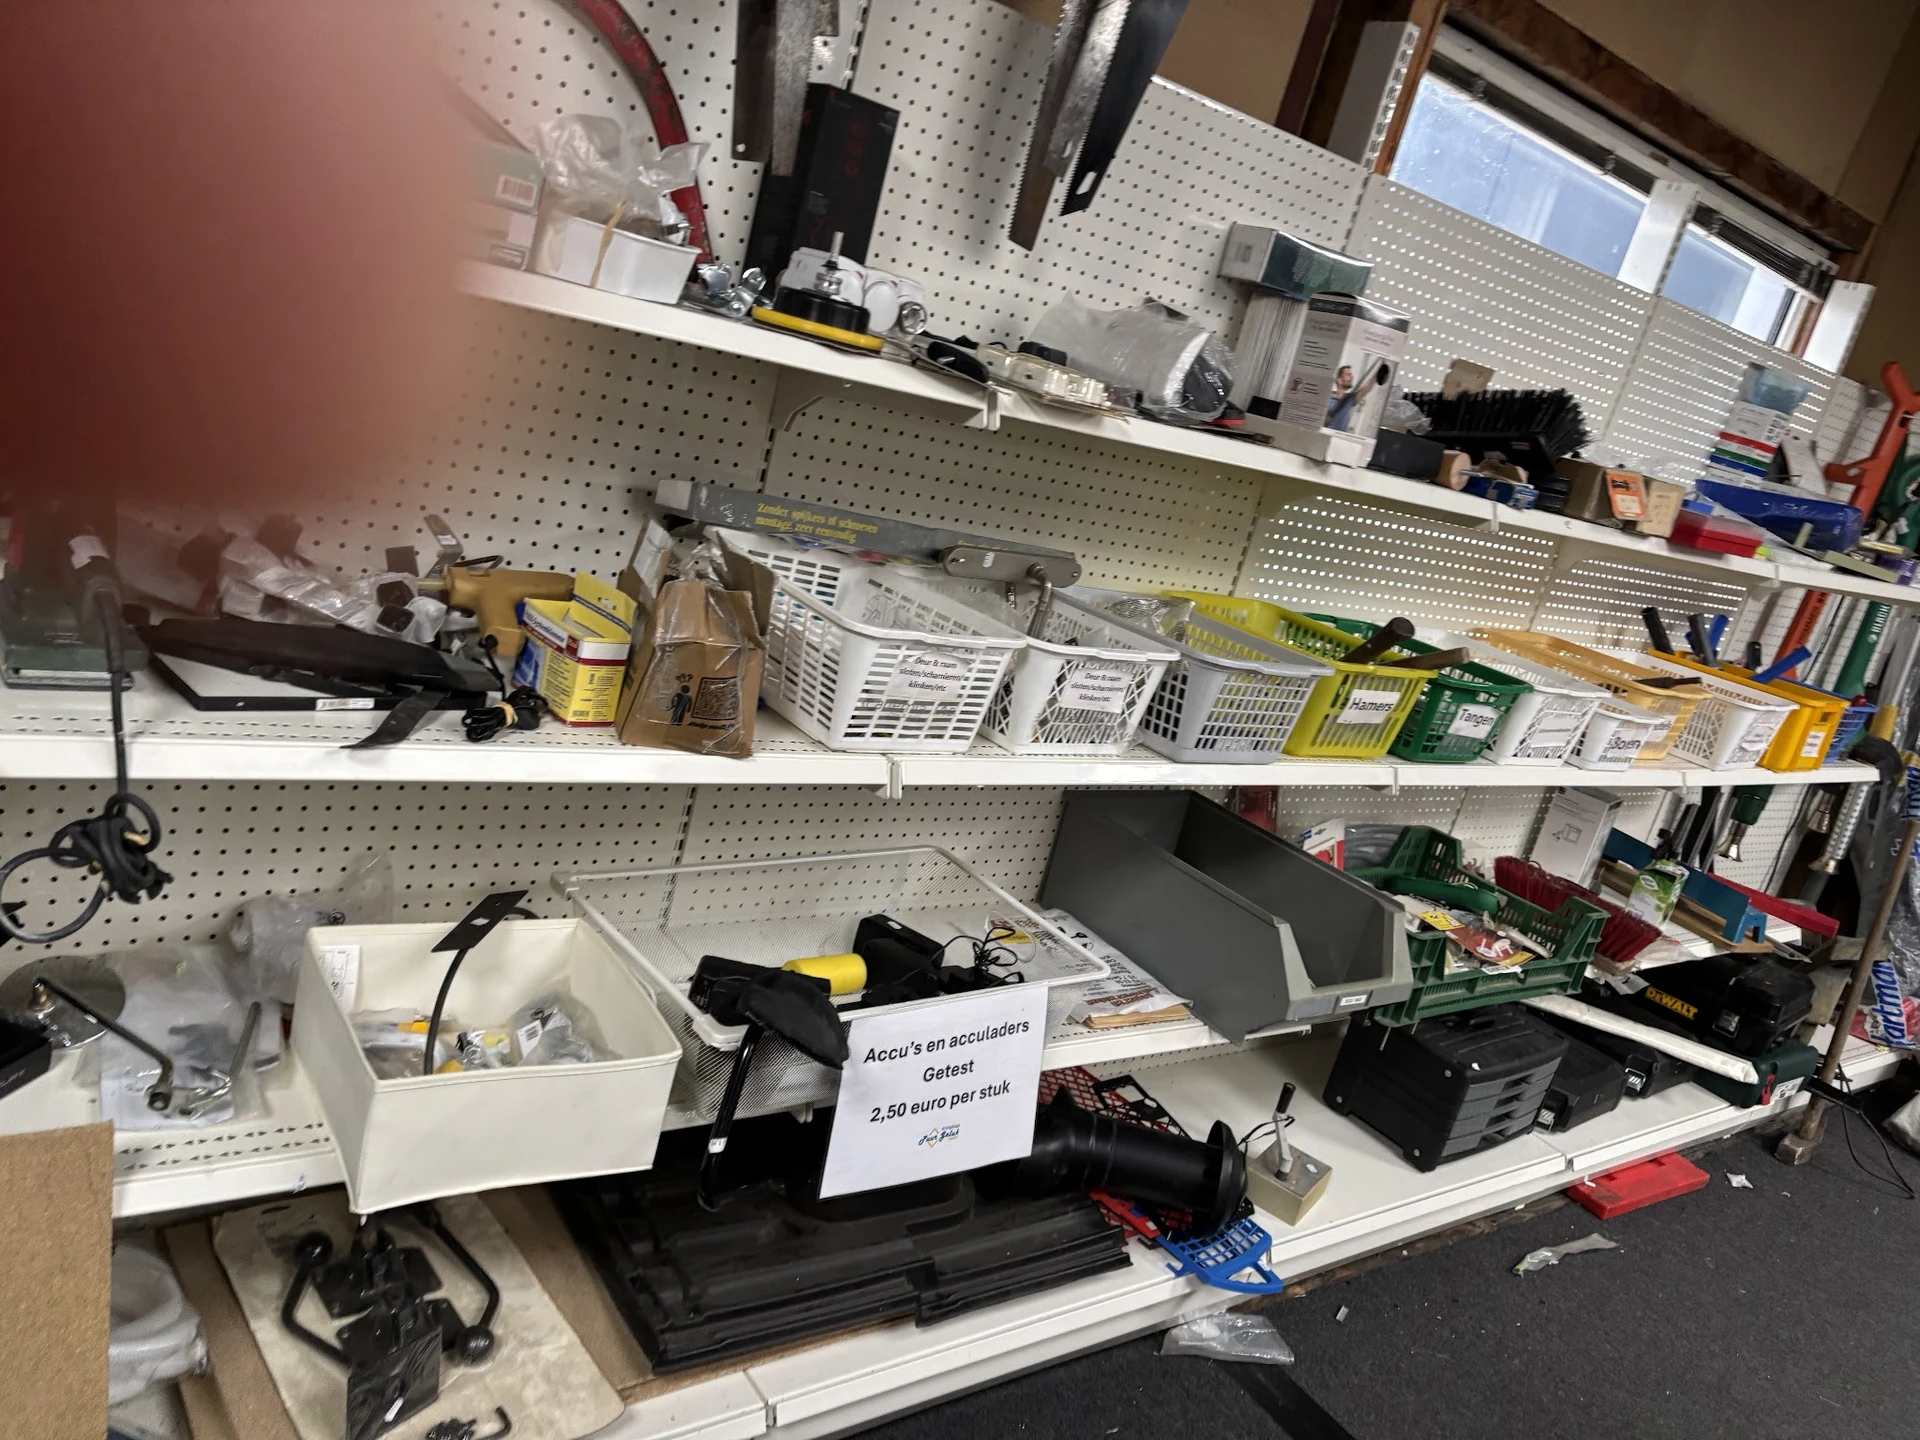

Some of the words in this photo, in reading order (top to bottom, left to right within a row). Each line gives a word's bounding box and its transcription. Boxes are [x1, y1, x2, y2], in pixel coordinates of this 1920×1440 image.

[757, 503, 789, 517] Zonder
[914, 656, 932, 666] Deur
[1348, 698, 1394, 712] Hamers
[1458, 708, 1495, 728] Tangen
[863, 1041, 922, 1064] Accu's
[926, 1038, 946, 1052] en
[949, 1019, 1030, 1048] acculaders
[923, 1059, 975, 1083] Getest
[869, 1103, 907, 1125] 2,50
[910, 1096, 946, 1115] euro
[949, 1088, 977, 1110] per
[979, 1080, 1011, 1100] stuk
